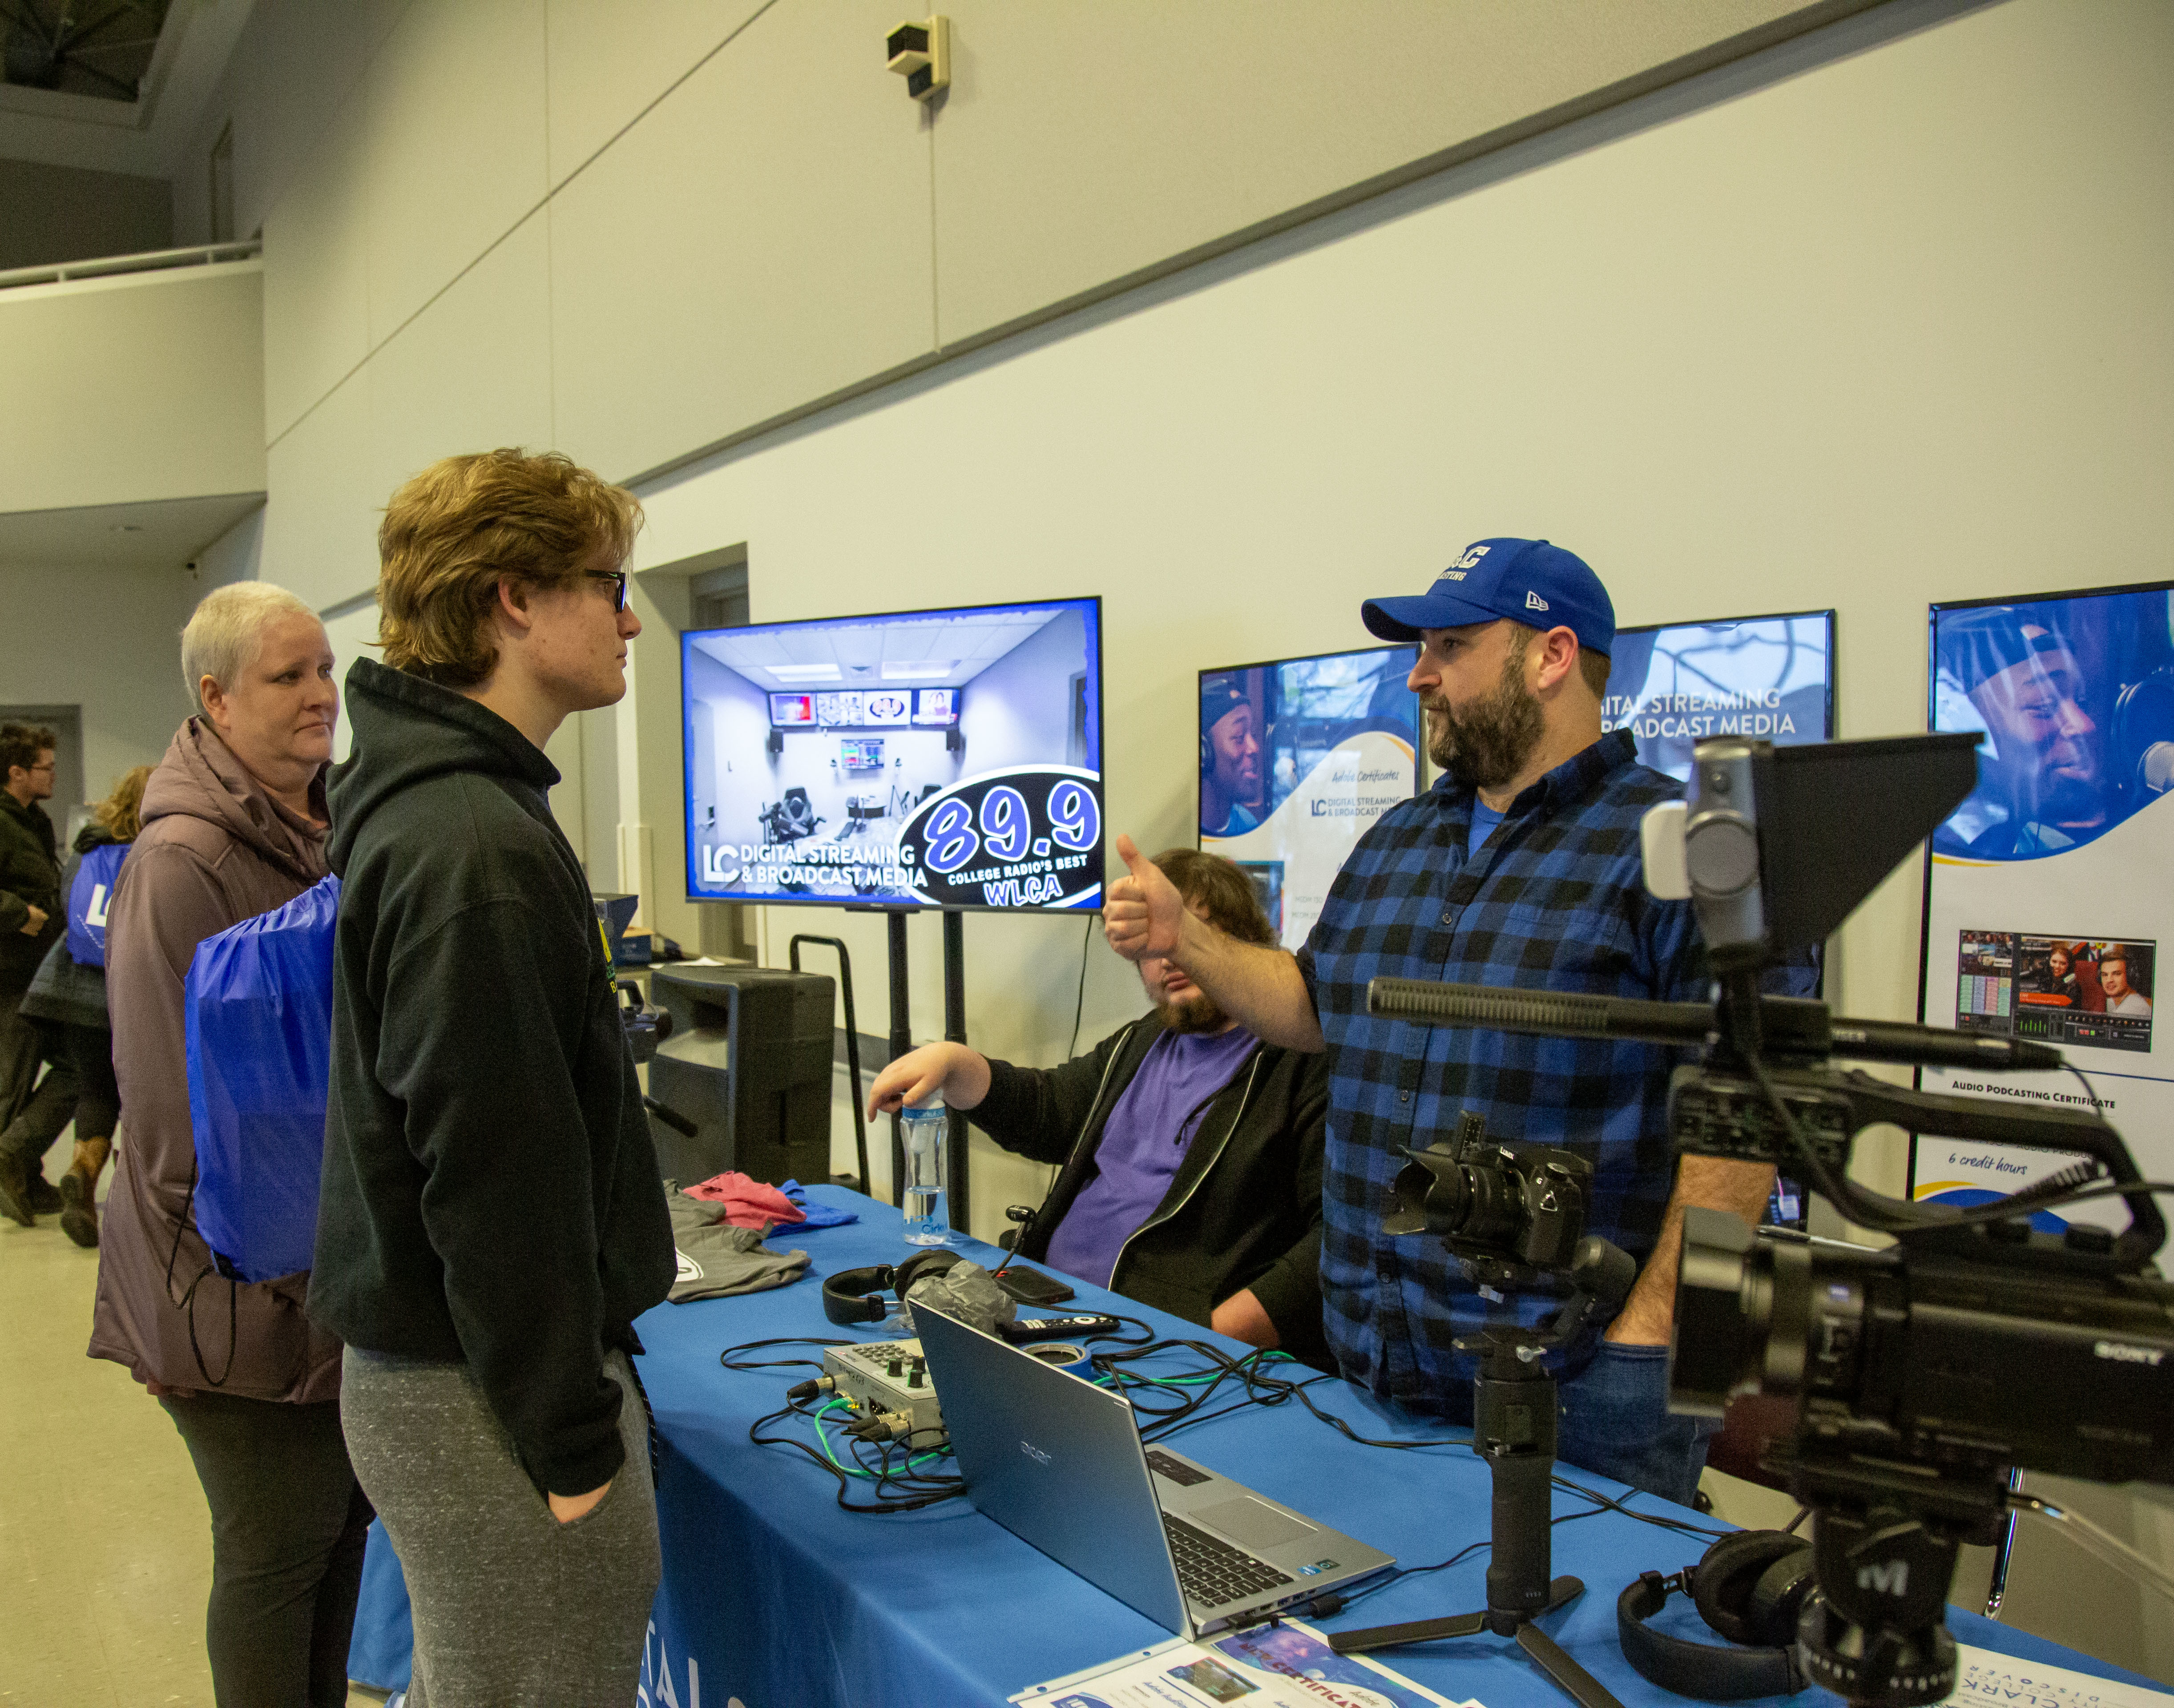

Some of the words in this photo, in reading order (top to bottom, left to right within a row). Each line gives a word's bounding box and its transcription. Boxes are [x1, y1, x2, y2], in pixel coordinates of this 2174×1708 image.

[1601, 696, 1646, 716] ITAL
[1651, 688, 1780, 713] STREAMING
[1719, 713, 1796, 735] MEDIA
[1311, 799, 1327, 817] LC
[1328, 797, 1356, 807] DIGITAL
[1357, 796, 1401, 806] STREAMING
[1335, 807, 1379, 817] BROADCAST
[923, 779, 1101, 874] 89.9
[703, 845, 740, 882] LC
[741, 845, 803, 863] DIGITAL
[810, 845, 915, 865] STREAMING
[741, 865, 753, 883] &
[757, 866, 862, 886] BROADCAST
[865, 866, 929, 888] MEDIA
[948, 867, 1001, 886] COLLEGE
[1003, 859, 1053, 878] RADIO'S
[1055, 854, 1088, 870] BEST
[983, 873, 1064, 907] WLCA
[85, 883, 112, 927] L
[1948, 1152, 1956, 1164] 6
[1960, 1155, 1995, 1170] credit
[1996, 1157, 2028, 1176] hours
